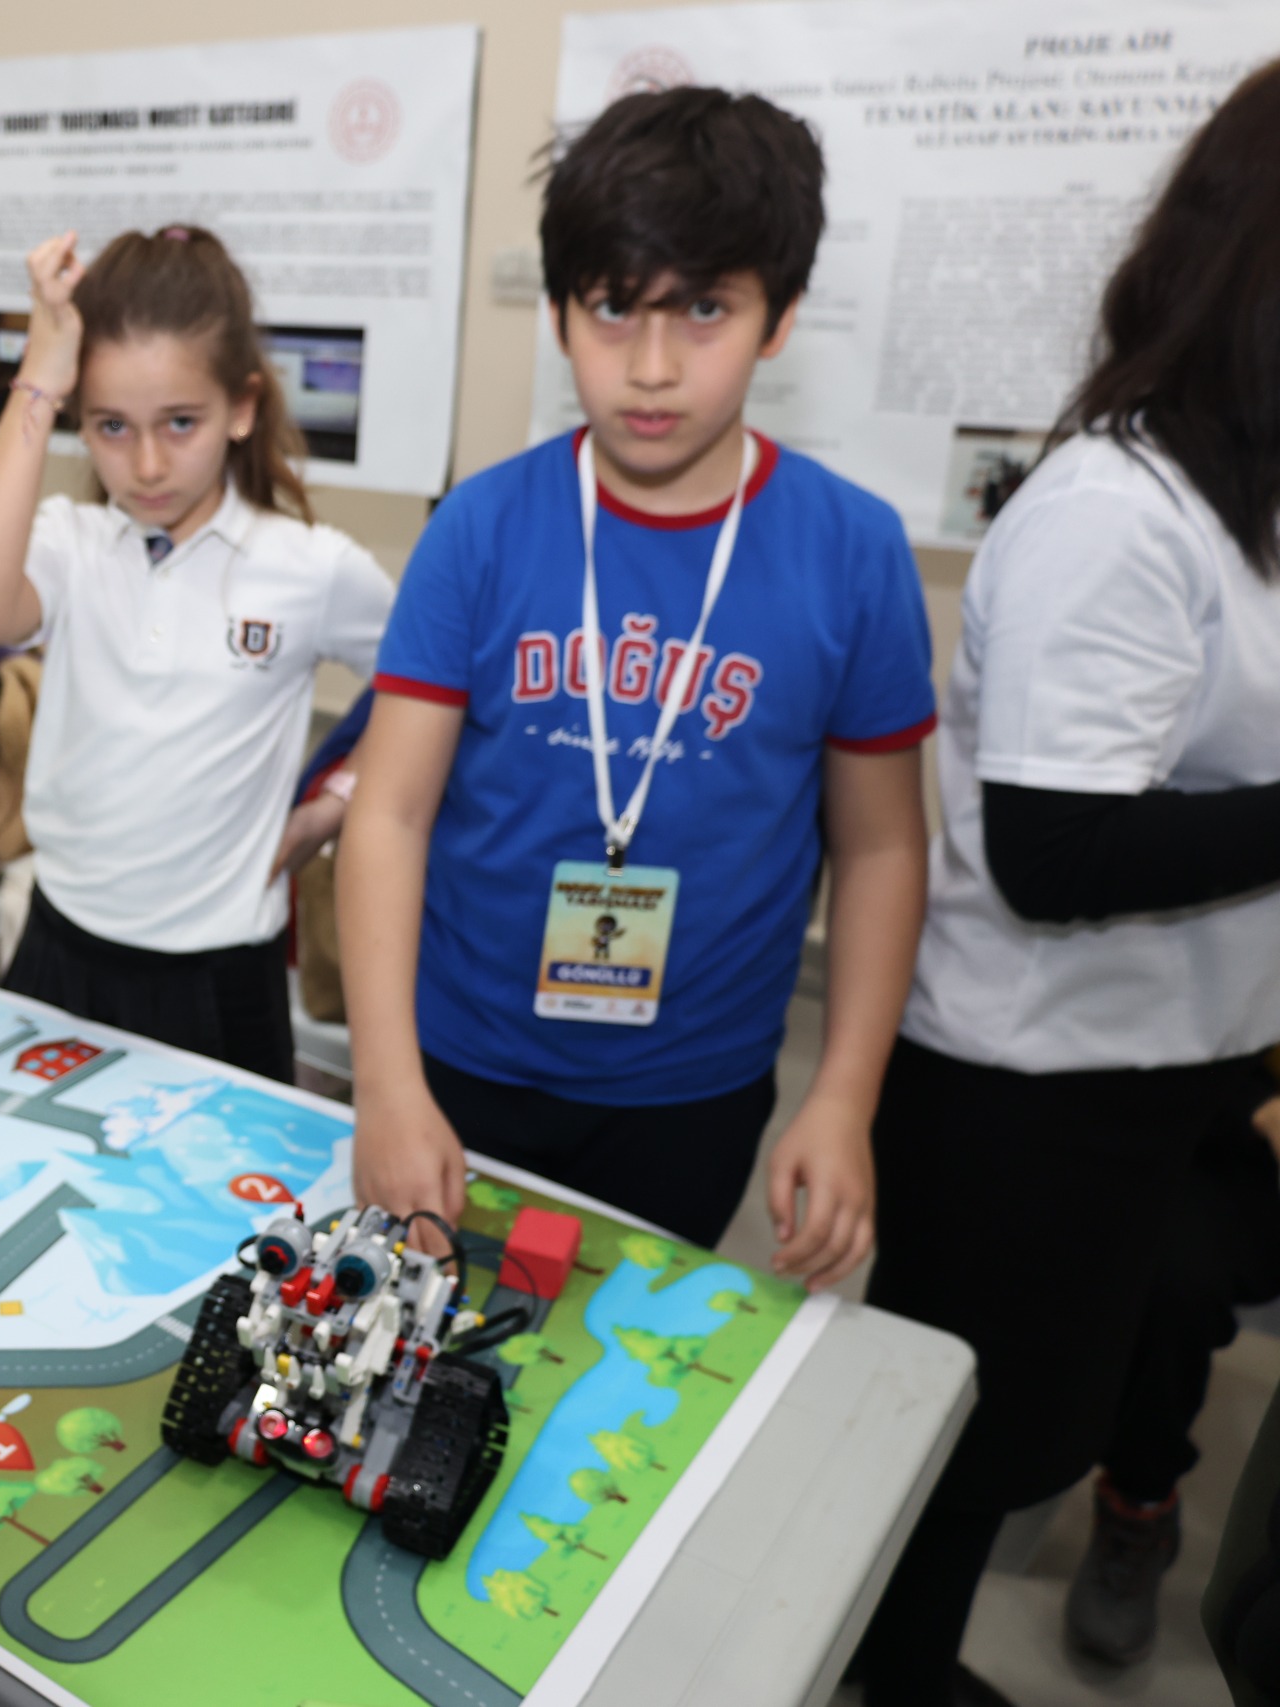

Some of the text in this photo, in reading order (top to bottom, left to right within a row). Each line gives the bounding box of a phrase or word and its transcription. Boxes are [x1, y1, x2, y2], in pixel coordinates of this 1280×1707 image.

[1024, 33, 1111, 58] PROJE
[512, 613, 762, 741] DOĞUŞ
[546, 722, 619, 755] sine
[557, 964, 643, 986] GÖNÜLLÜ
[239, 1177, 281, 1201] 2
